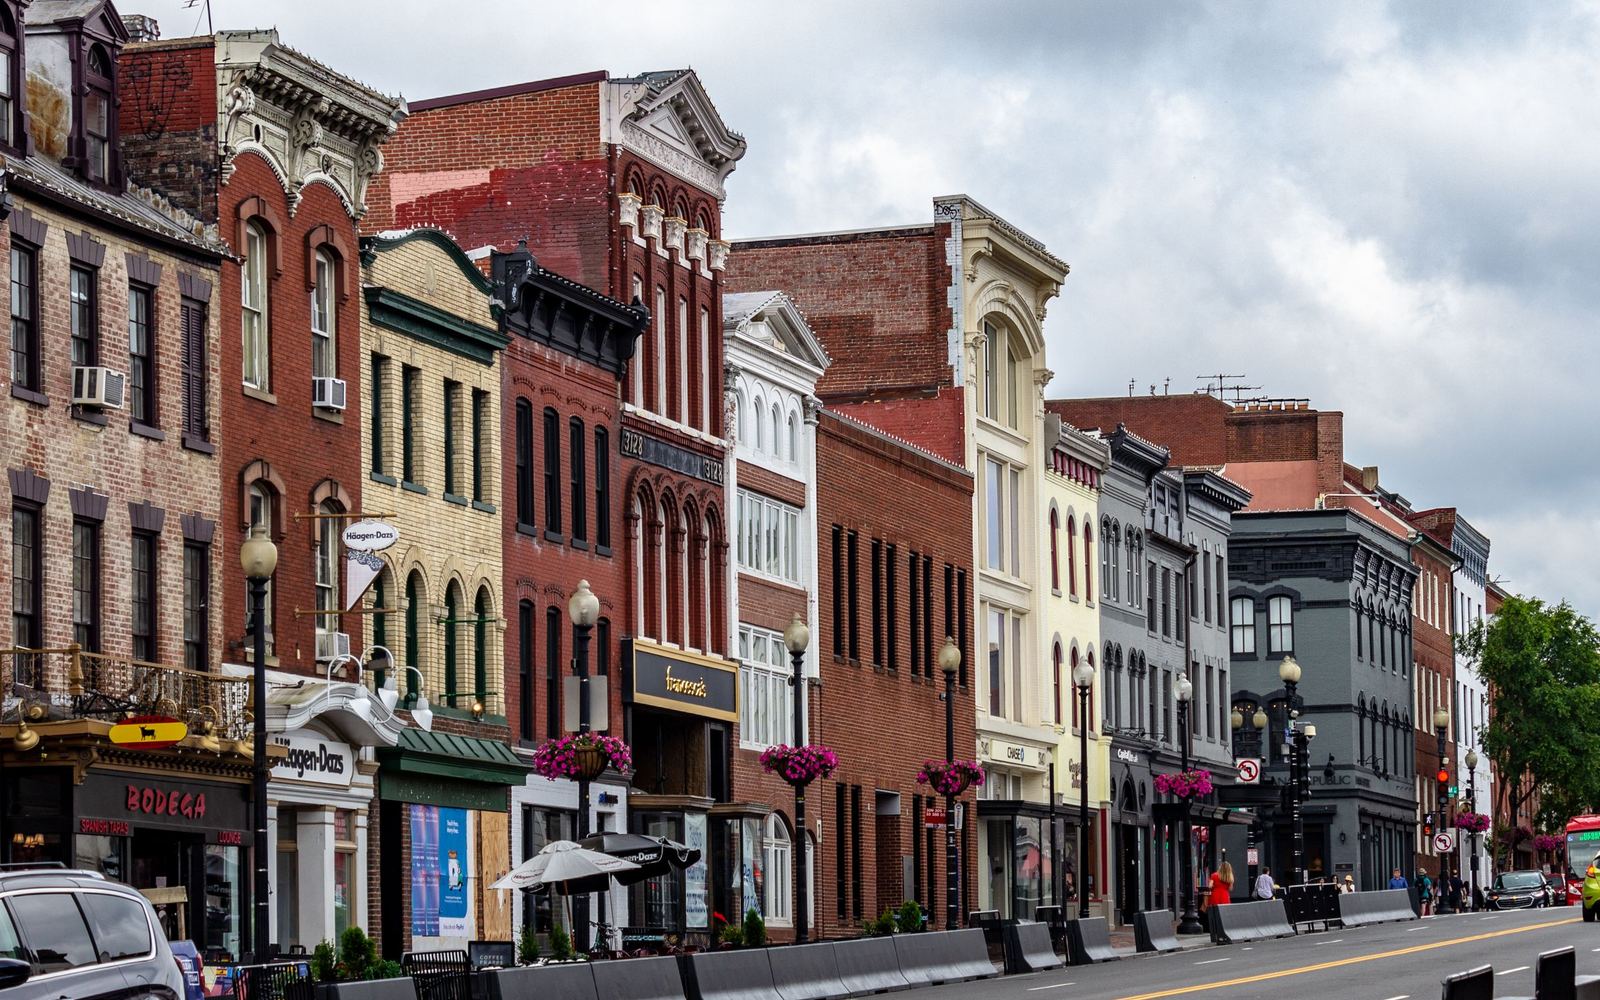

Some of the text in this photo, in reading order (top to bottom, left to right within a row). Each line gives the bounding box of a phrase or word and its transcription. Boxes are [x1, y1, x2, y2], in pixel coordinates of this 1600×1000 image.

[624, 432, 644, 455] 3128
[704, 460, 723, 482] 3128
[346, 531, 393, 541] Häagen-Dazs
[1007, 746, 1021, 760] CHASE
[1313, 775, 1350, 787] PUBLIC
[127, 784, 206, 819] BODEGA
[80, 818, 128, 835] SPANISH TAPAS
[219, 831, 241, 844] LOUNGE
